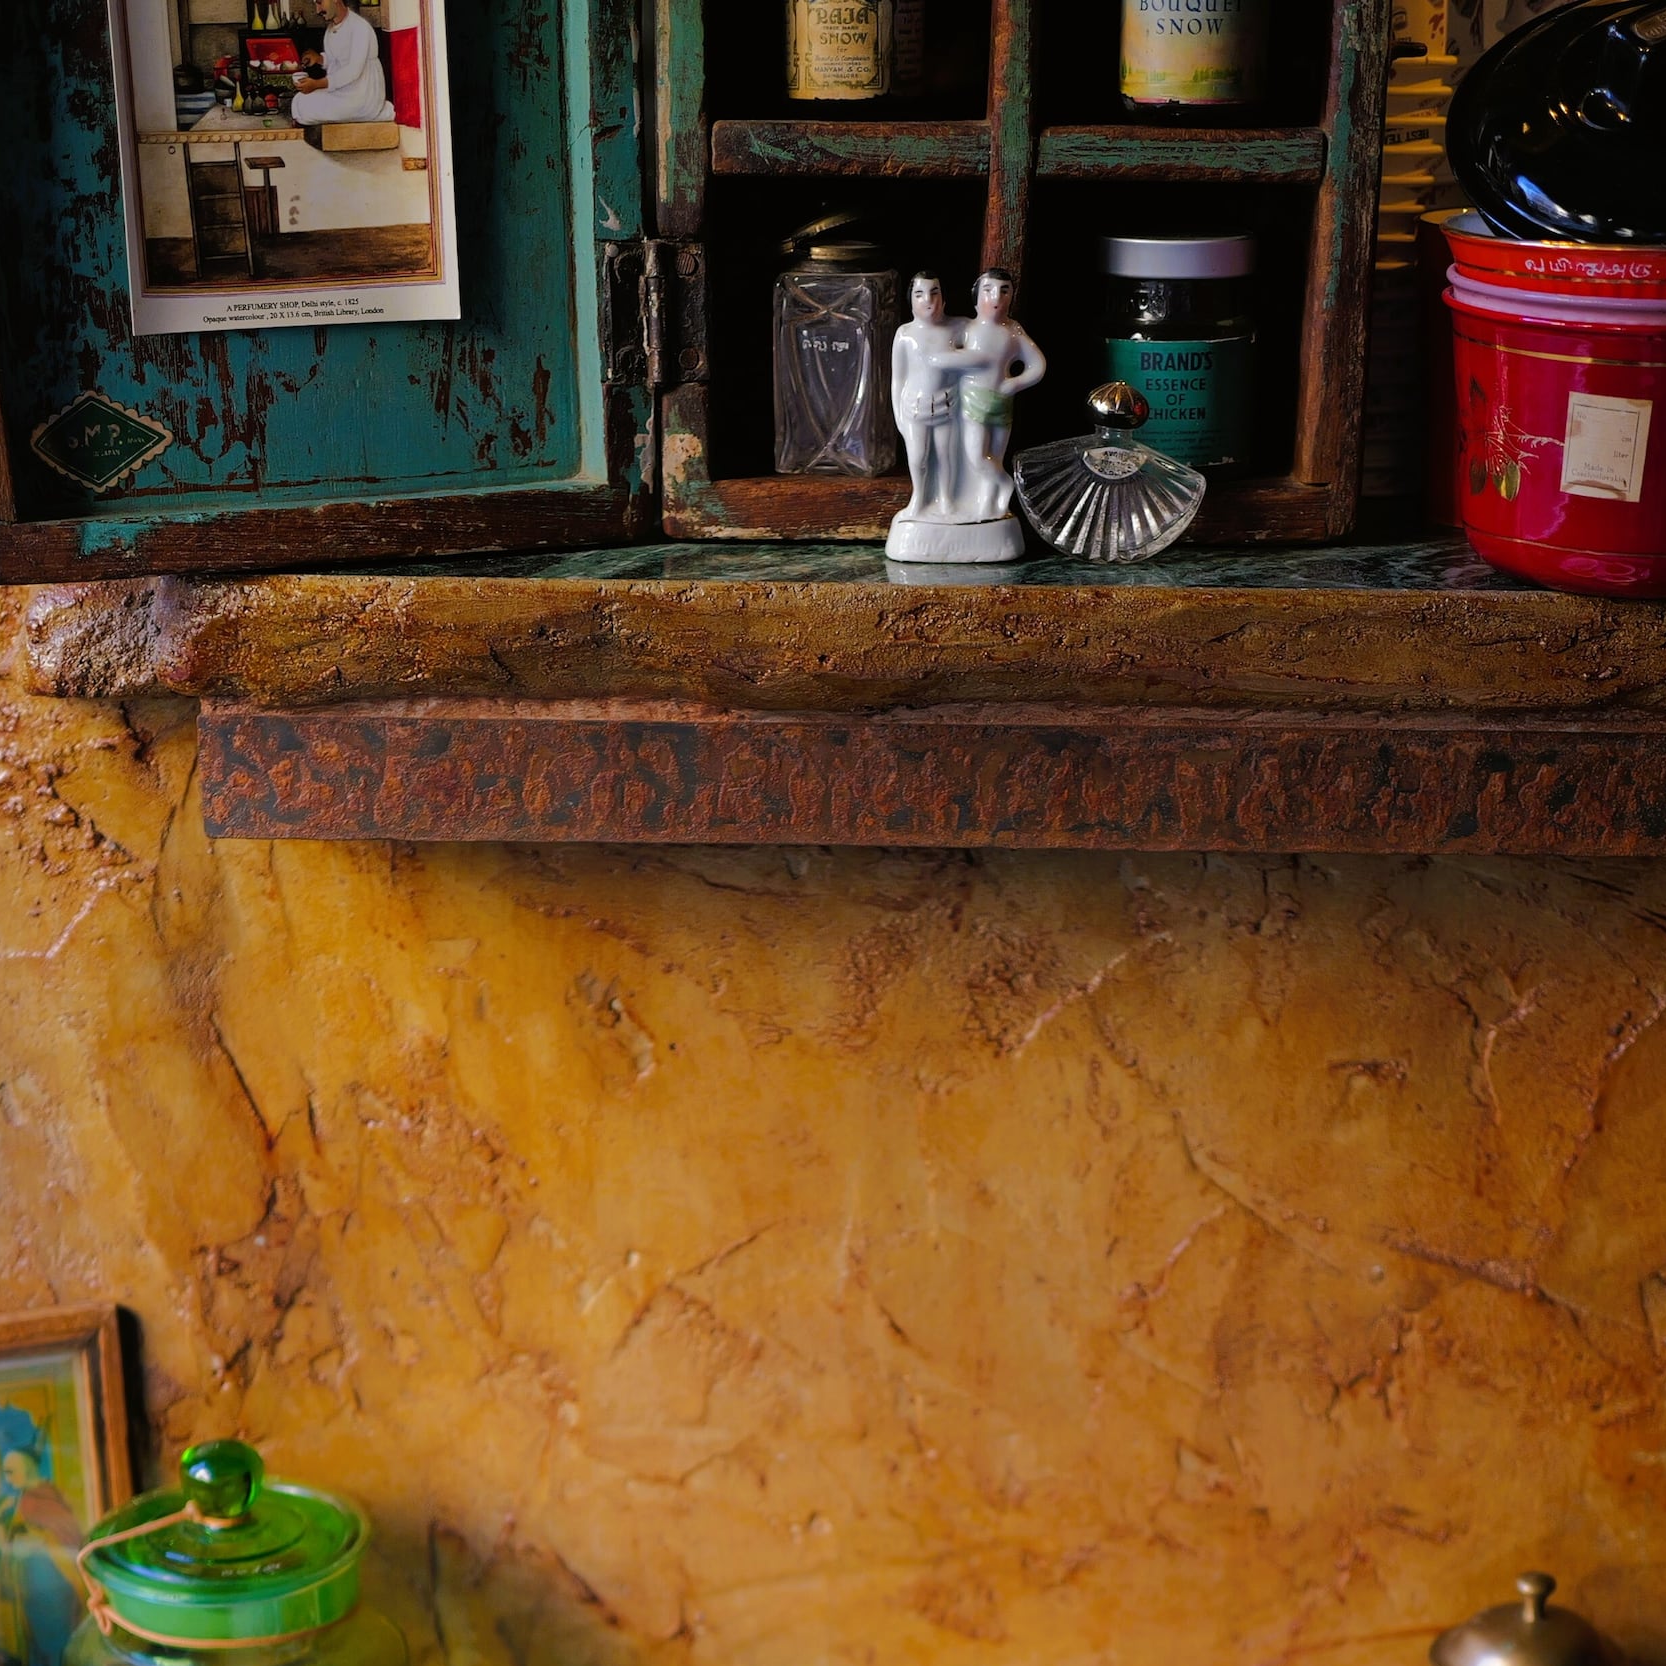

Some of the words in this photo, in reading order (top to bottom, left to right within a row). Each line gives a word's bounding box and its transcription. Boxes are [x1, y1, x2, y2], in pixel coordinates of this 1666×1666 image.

[814, 8, 869, 24] RAJA
[1156, 19, 1223, 34] SNOW
[820, 32, 869, 45] SNOW
[234, 303, 278, 311] PERFUMERY
[280, 302, 301, 310] SHOP,
[302, 300, 319, 308] Delhi
[319, 300, 336, 308] style,
[203, 315, 227, 324] Opaque
[229, 313, 265, 321] watercolour
[279, 311, 286, 319] X
[287, 311, 301, 319] 13.6
[314, 309, 335, 317] British
[336, 307, 360, 316] Library,
[361, 307, 384, 315] London
[1140, 351, 1213, 371] BRAND'S
[1145, 378, 1206, 391] ESSENCE
[1165, 394, 1186, 405] OF
[1583, 462, 1604, 472] Made
